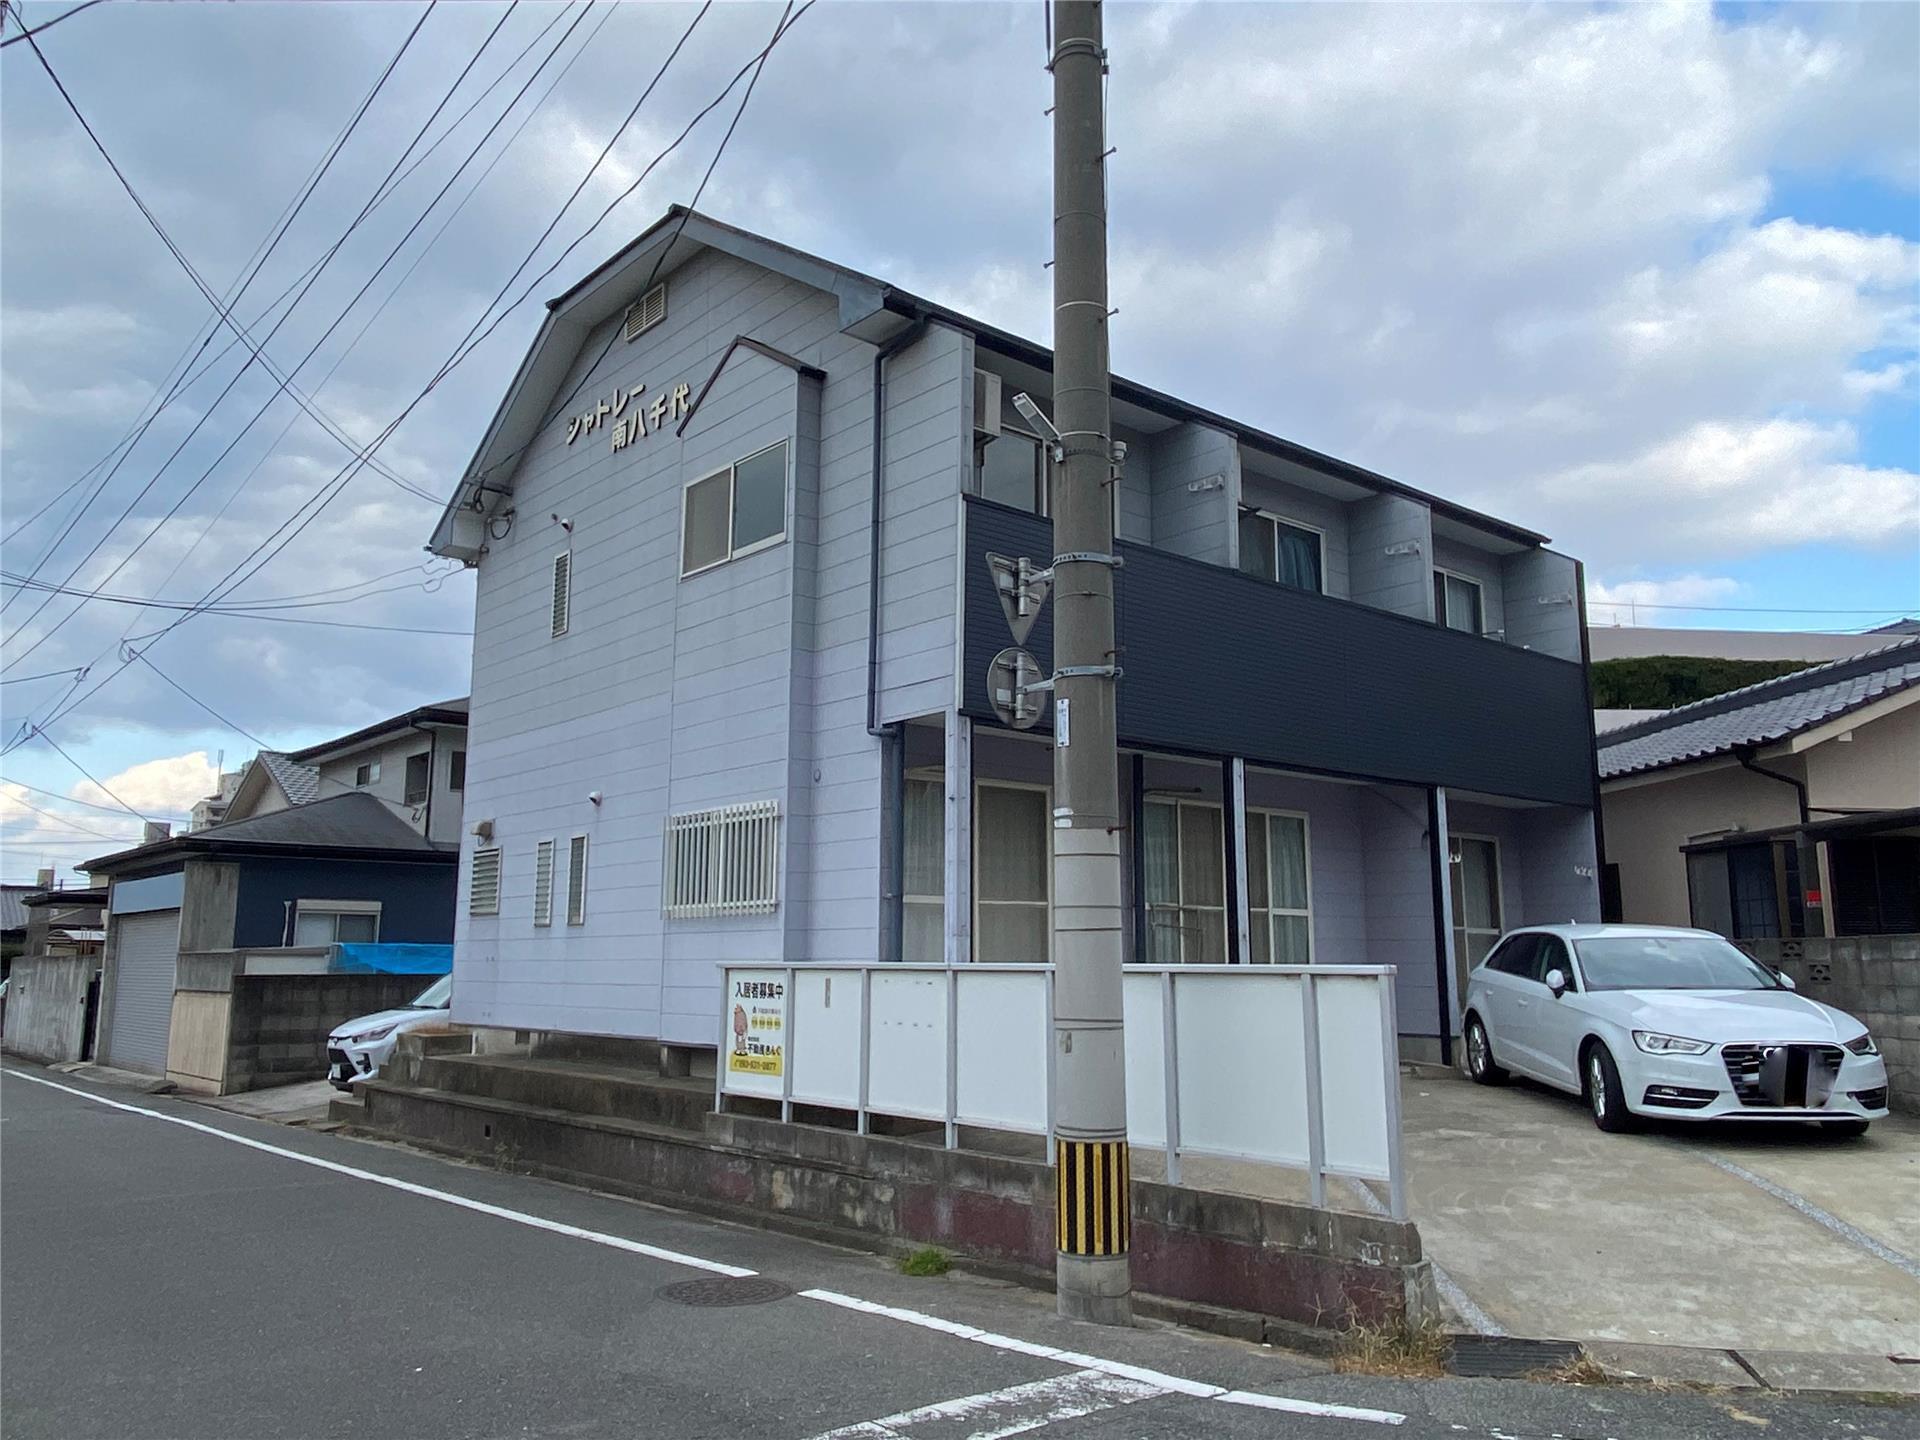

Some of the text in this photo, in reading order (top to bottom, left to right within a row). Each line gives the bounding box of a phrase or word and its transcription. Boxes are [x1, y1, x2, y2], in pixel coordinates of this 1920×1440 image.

[566, 384, 646, 446] シャトレー
[611, 382, 691, 453] 南八千代
[734, 981, 784, 1000] 入居者募集中
